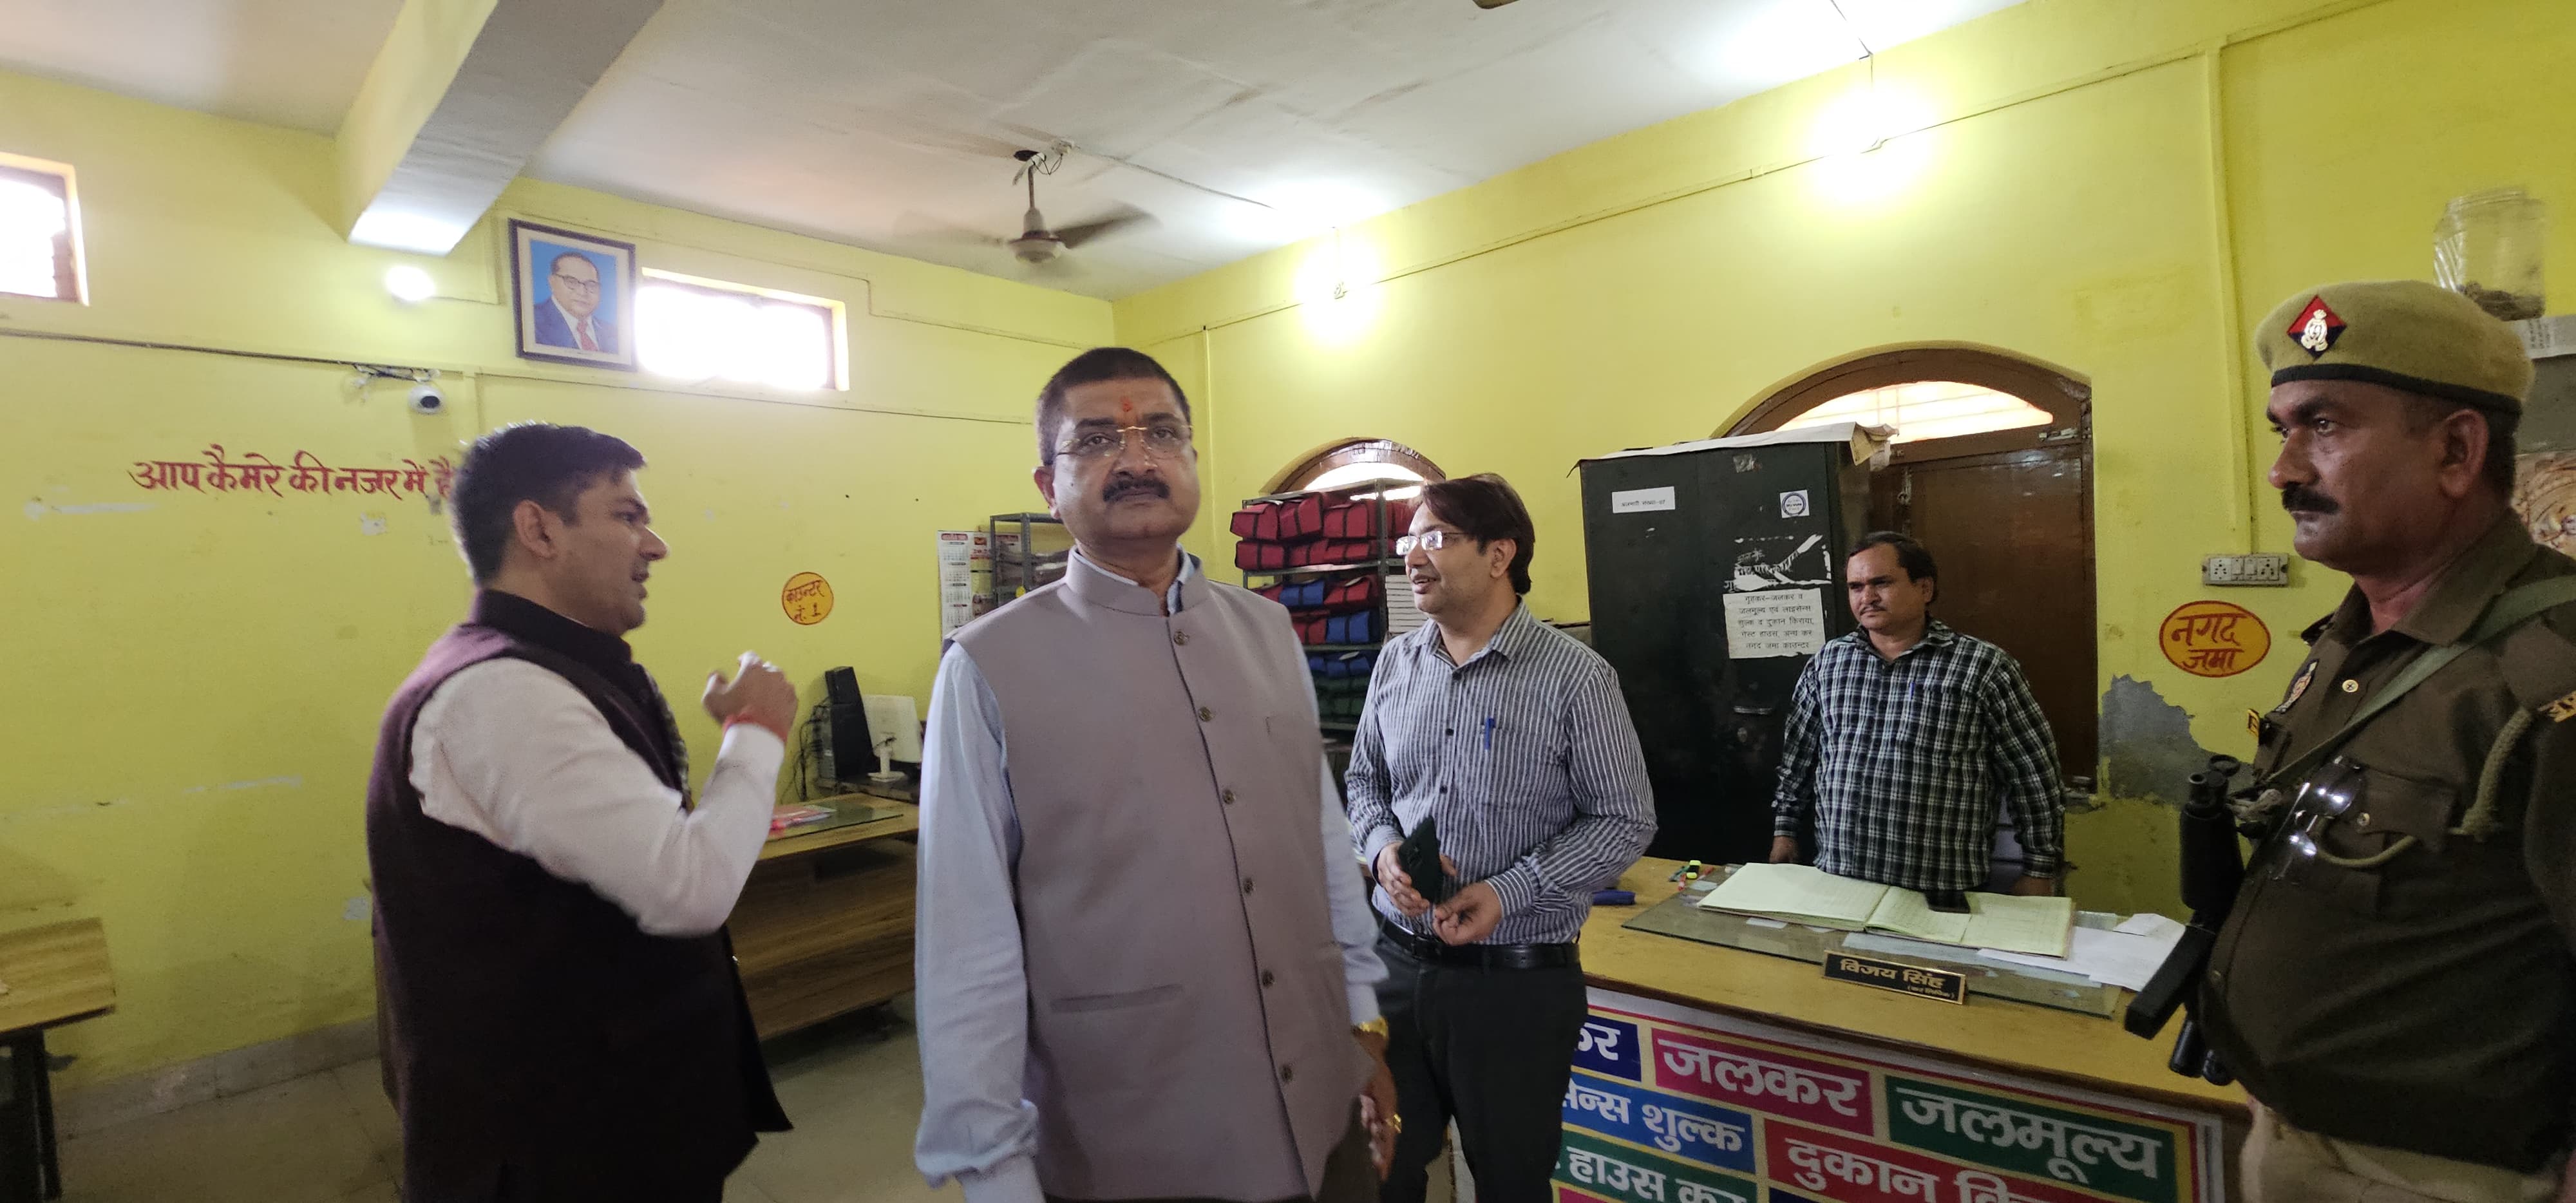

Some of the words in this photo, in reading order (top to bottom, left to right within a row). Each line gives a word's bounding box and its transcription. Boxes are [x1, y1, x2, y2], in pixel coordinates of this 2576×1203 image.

[128, 461, 207, 493] आप
[202, 444, 284, 498] कैमरे
[289, 450, 332, 495] की
[334, 467, 402, 500] नजर
[401, 459, 430, 498] में
[2171, 612, 2249, 646] नगद
[2182, 647, 2244, 671] जमा
[1839, 958, 1898, 980] विजय
[1902, 969, 1946, 989] सिंह
[1657, 1038, 1862, 1117] जलकर
[1642, 1104, 1745, 1152] शुल्क
[1895, 1086, 2163, 1185] जलमूल्य
[1566, 1146, 1667, 1202] हाउस
[1785, 1137, 1939, 1203] दुकान
